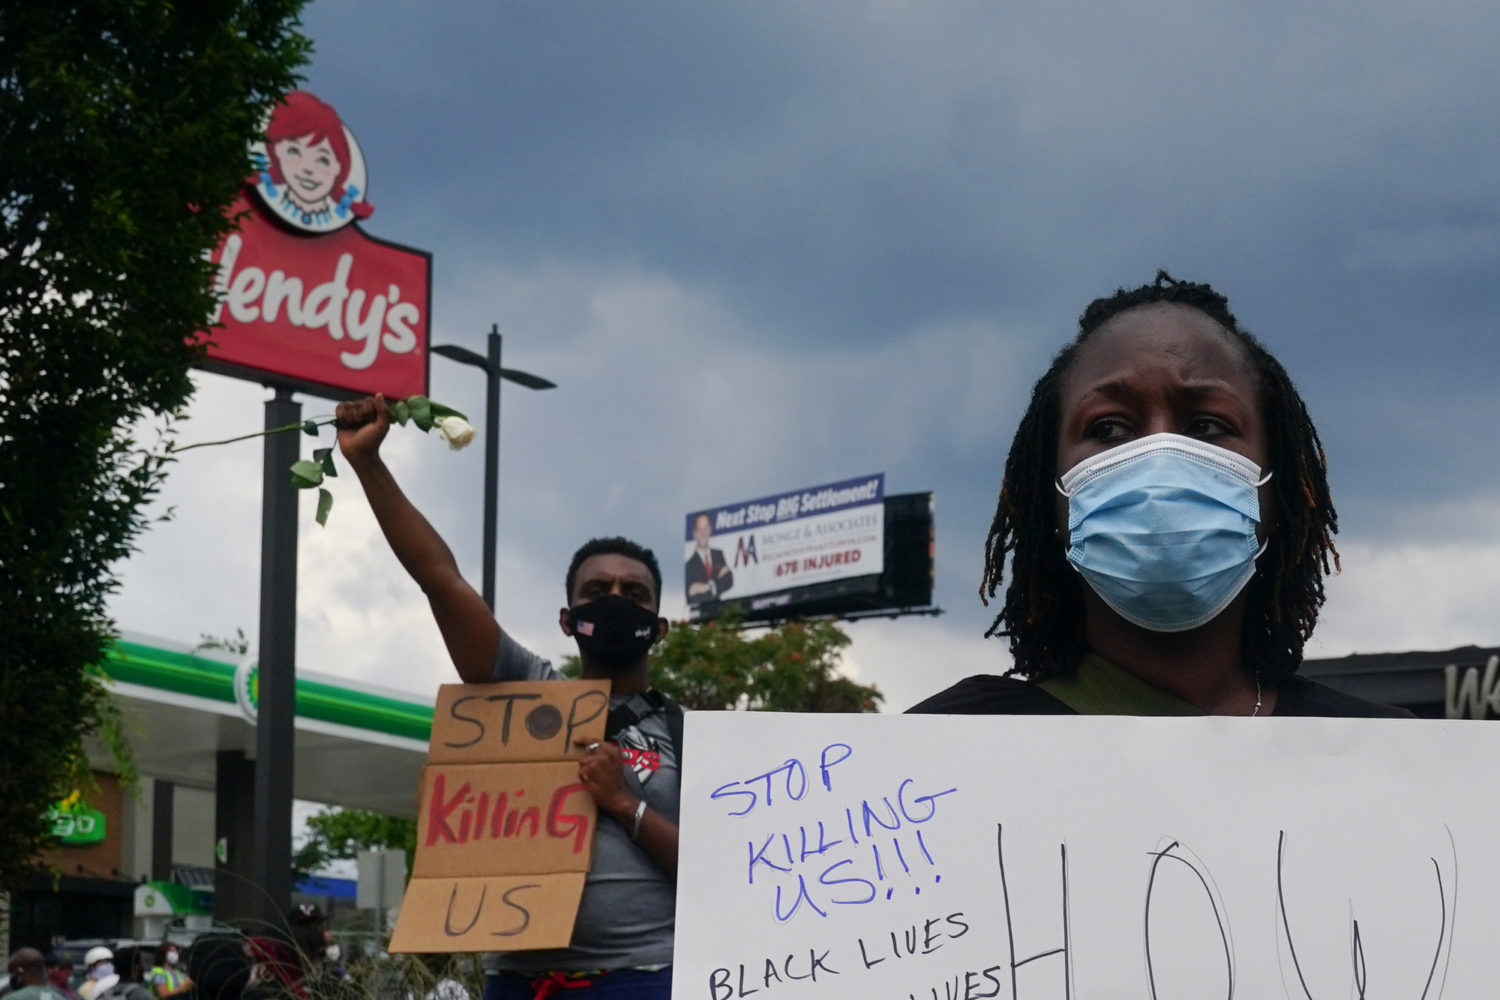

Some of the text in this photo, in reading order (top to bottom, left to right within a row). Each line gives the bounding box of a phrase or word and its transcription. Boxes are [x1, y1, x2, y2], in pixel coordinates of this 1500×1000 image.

[715, 507, 746, 531] Next
[746, 503, 776, 524] Stop
[777, 495, 800, 520] BIG
[775, 561, 799, 577] 678
[803, 549, 862, 571] INJURED
[443, 689, 608, 753] STOP
[710, 743, 852, 816] STOP
[748, 779, 957, 884] KILLING
[774, 830, 943, 921] US!!!
[444, 882, 542, 937] US
[859, 912, 970, 969] LIVES
